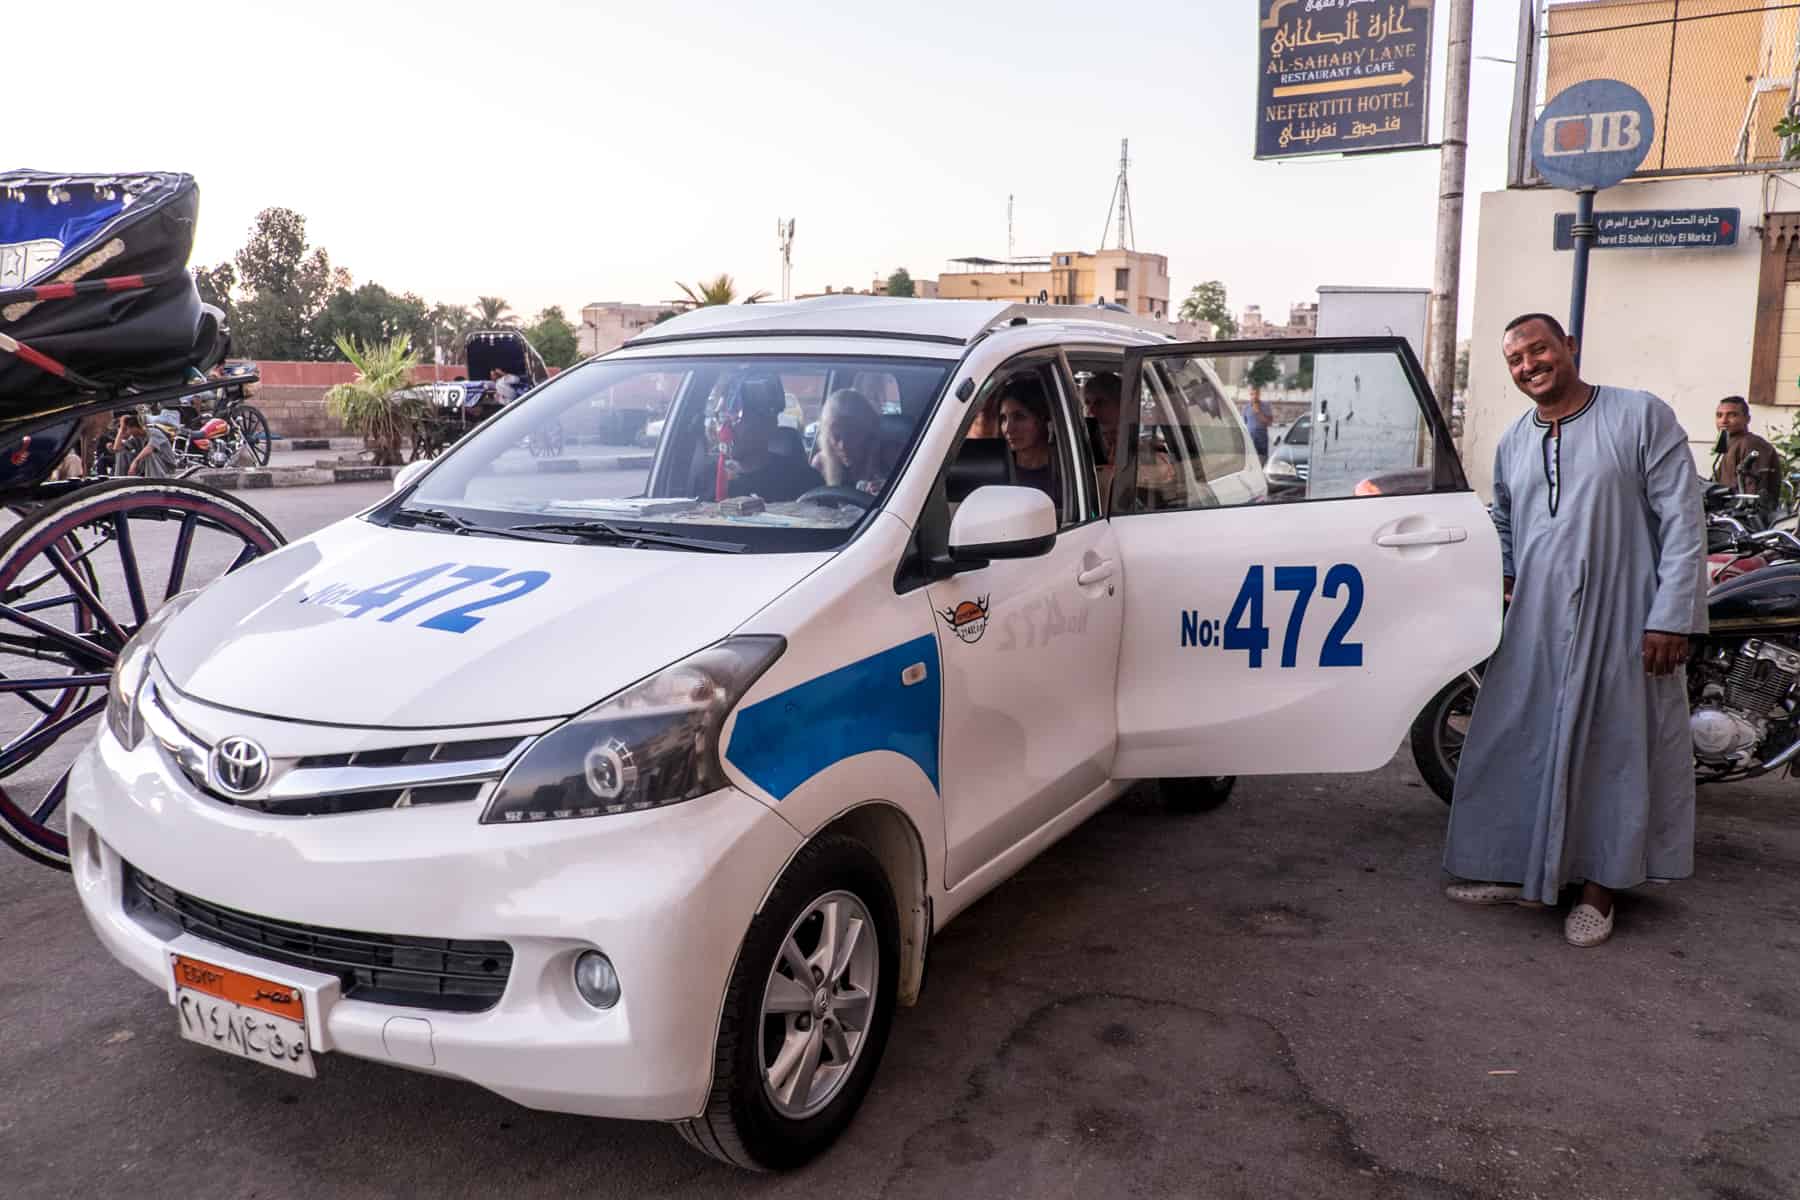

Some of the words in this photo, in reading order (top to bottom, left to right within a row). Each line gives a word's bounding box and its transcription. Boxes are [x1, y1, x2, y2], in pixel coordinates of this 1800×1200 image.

[1265, 49, 1365, 75] AL-SAHABY
[1369, 43, 1416, 62] LANE
[1280, 67, 1352, 84] RESTAURANT
[1353, 64, 1361, 75] &
[1365, 61, 1395, 73] CAFE
[1265, 97, 1353, 122] NEFERTITI
[1358, 91, 1414, 113] HOTEL
[1341, 116, 1401, 139] فندق
[1543, 110, 1641, 157] CIB
[1697, 214, 1720, 227] حارة
[341, 562, 551, 634] 472
[1181, 610, 1220, 647] No:
[1223, 563, 1364, 668] 472
[183, 963, 224, 991] EGYPT
[256, 989, 291, 1004] مصر
